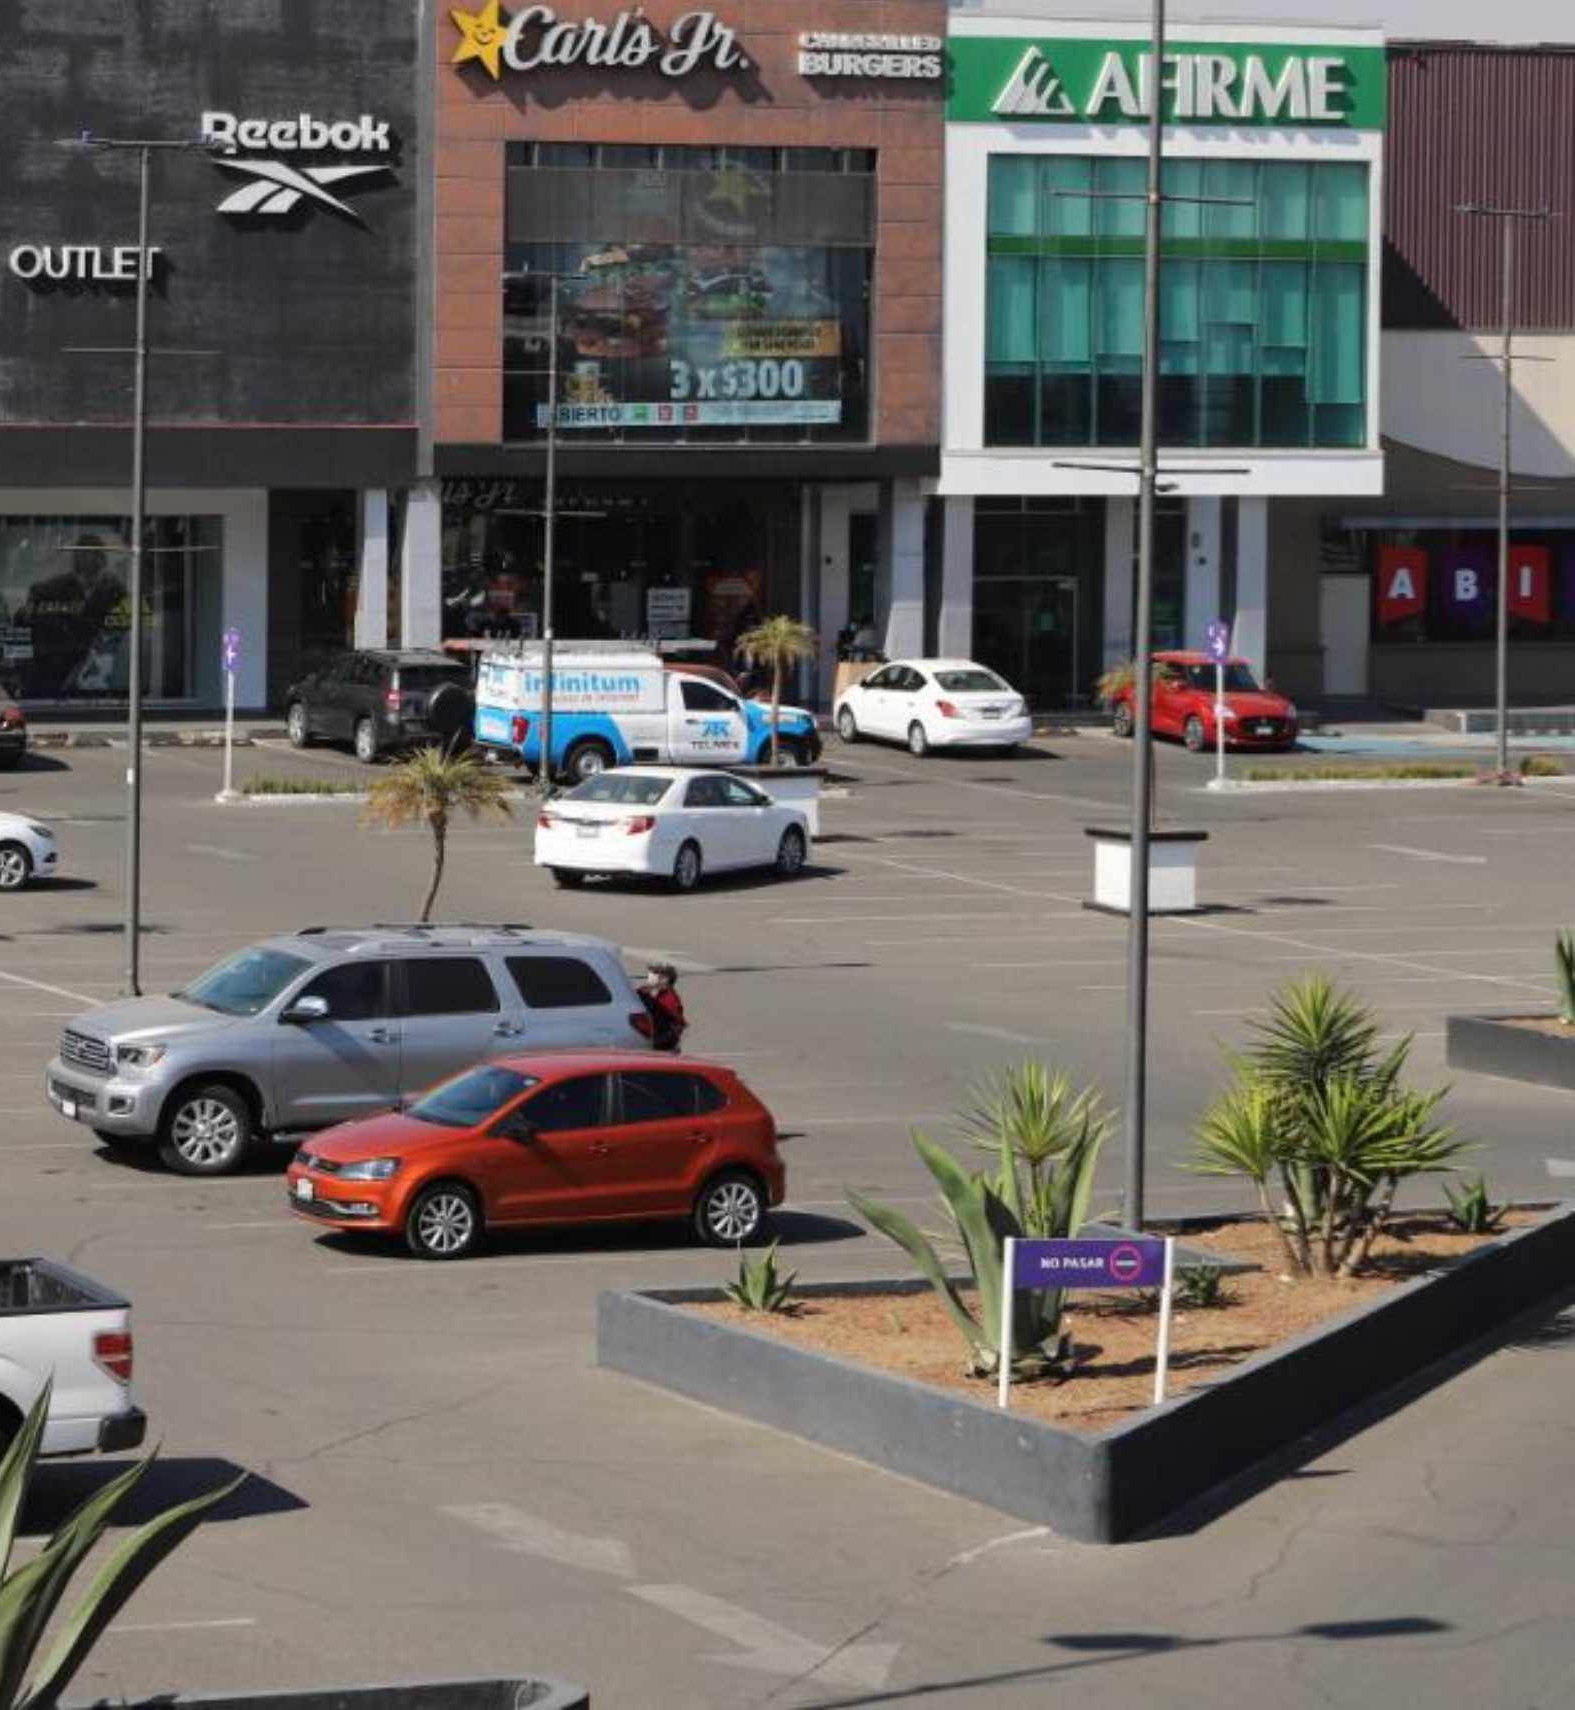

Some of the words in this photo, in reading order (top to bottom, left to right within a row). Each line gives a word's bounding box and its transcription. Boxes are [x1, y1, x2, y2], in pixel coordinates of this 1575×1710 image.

[502, 4, 661, 71] Carl's
[660, 11, 751, 76] Jr.
[798, 51, 942, 78] BURGERS
[1085, 51, 1345, 120] AFIRME
[201, 110, 391, 155] Reebok
[10, 244, 162, 279] OUTLET
[670, 359, 690, 398] 3
[721, 358, 804, 398] $300
[546, 404, 622, 422] BIERTO
[1040, 1256, 1060, 1270] NO
[1063, 1255, 1105, 1269] PASAR
